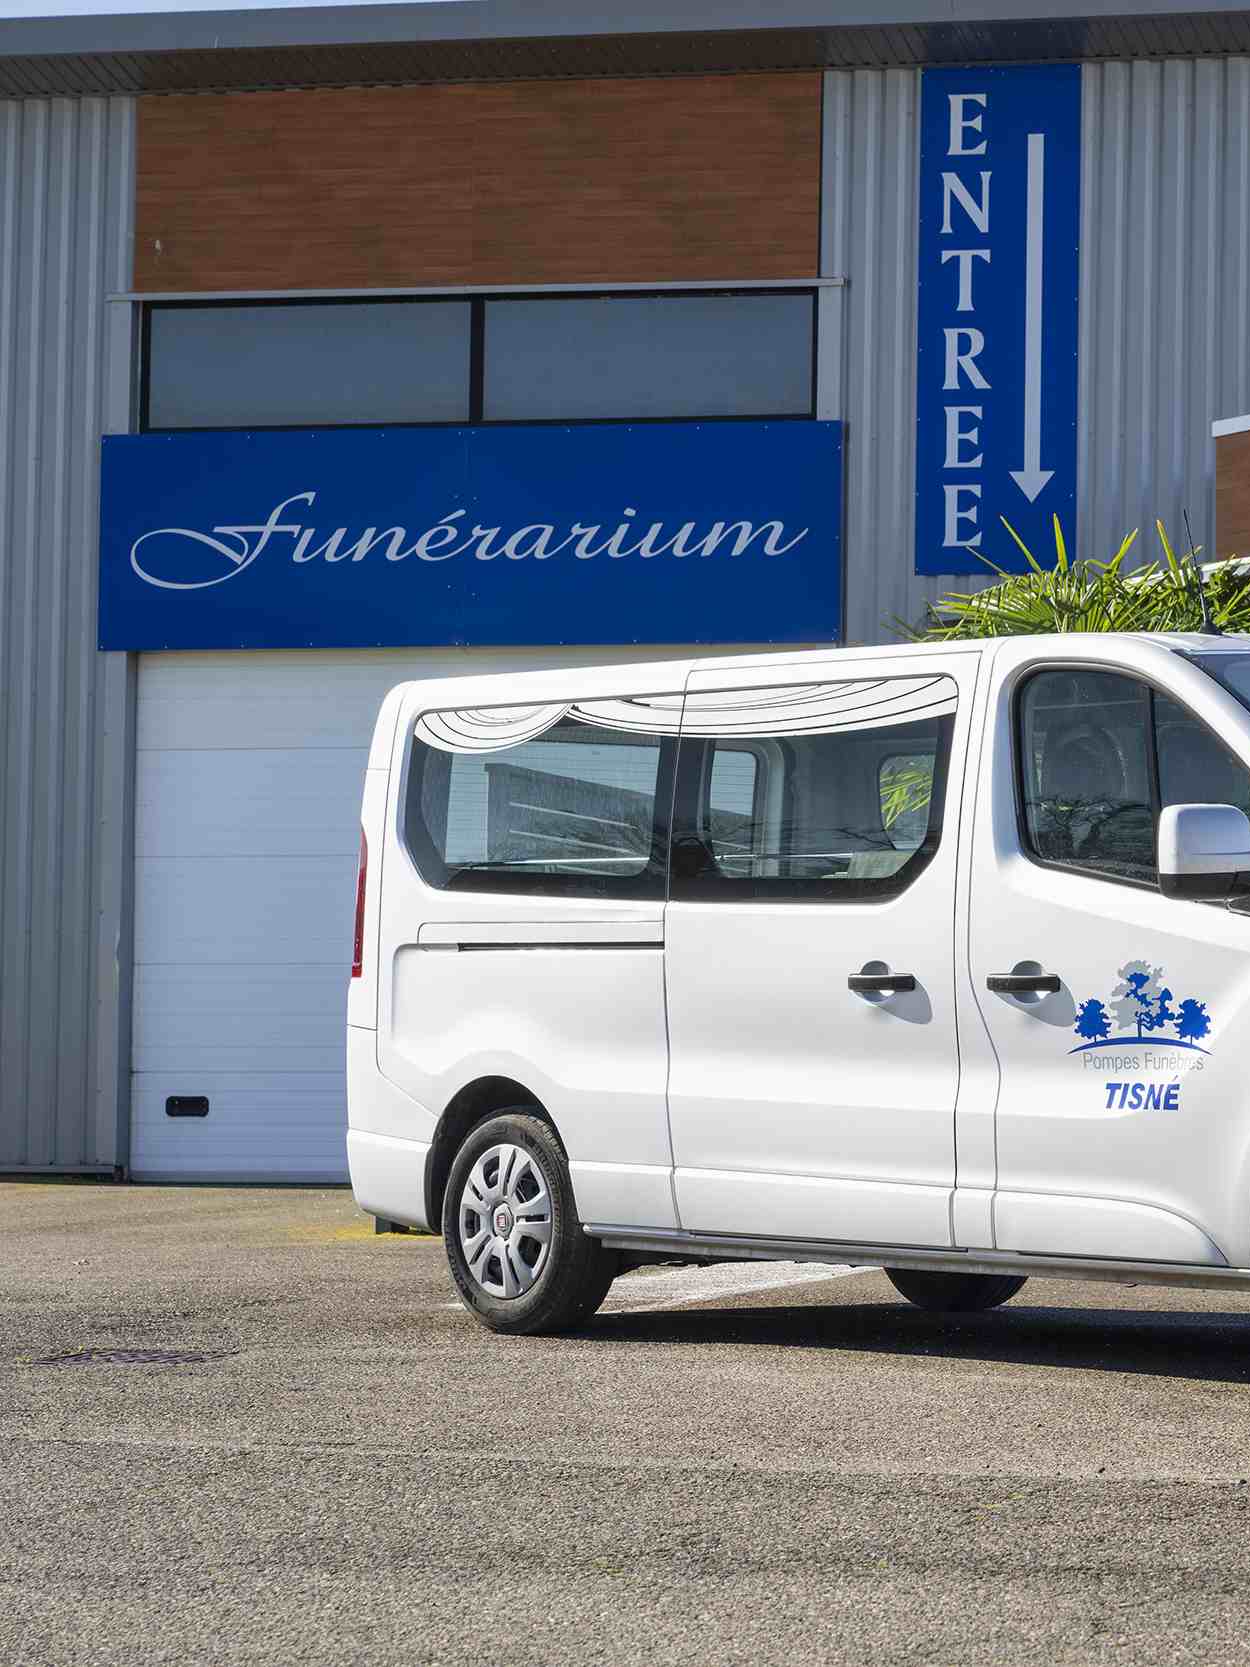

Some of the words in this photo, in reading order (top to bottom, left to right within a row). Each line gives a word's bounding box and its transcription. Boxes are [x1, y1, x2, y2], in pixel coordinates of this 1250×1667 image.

[941, 94, 992, 547] ENTREE
[131, 491, 808, 590] Funérarium
[1082, 1052, 1140, 1073] Pompes
[1144, 1052, 1205, 1071] Funèbs
[1105, 1075, 1180, 1112] TISNÉ
